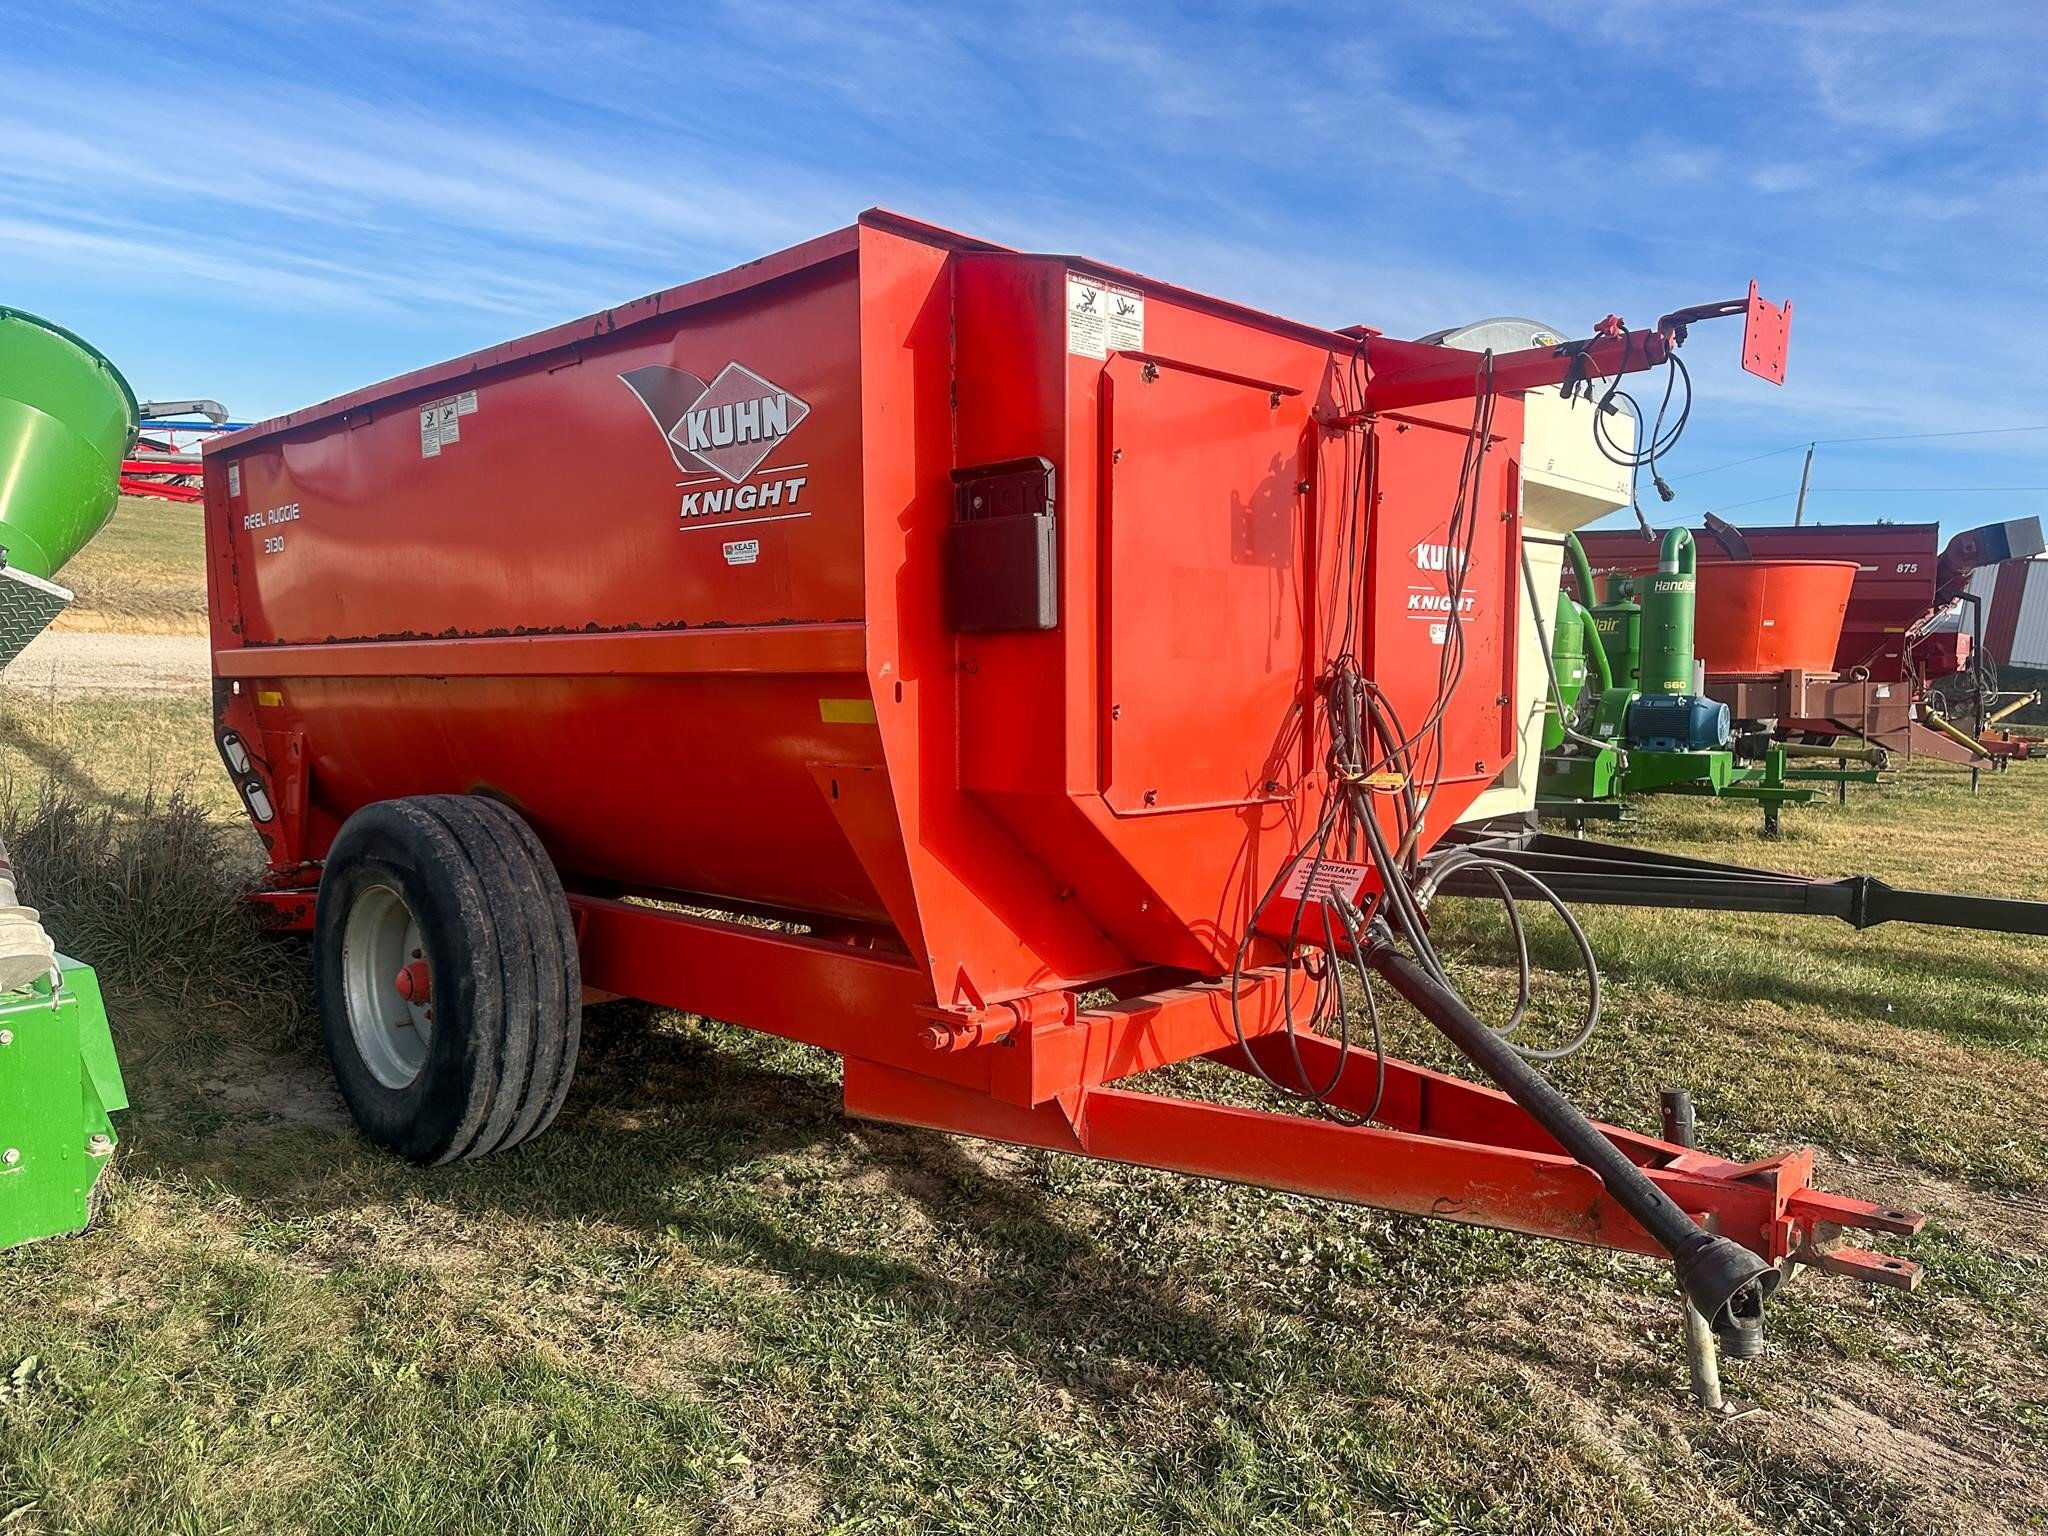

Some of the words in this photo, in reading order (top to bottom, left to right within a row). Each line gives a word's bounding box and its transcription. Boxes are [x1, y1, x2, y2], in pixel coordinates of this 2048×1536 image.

[686, 392, 788, 451] KUHN
[680, 478, 806, 518] KNIGHT
[244, 512, 266, 530] REEL
[268, 503, 299, 525] AUGGIE
[264, 535, 285, 554] 3130
[734, 541, 757, 551] KEAST
[1896, 563, 1919, 573] 875
[1654, 579, 1696, 592] Handlai
